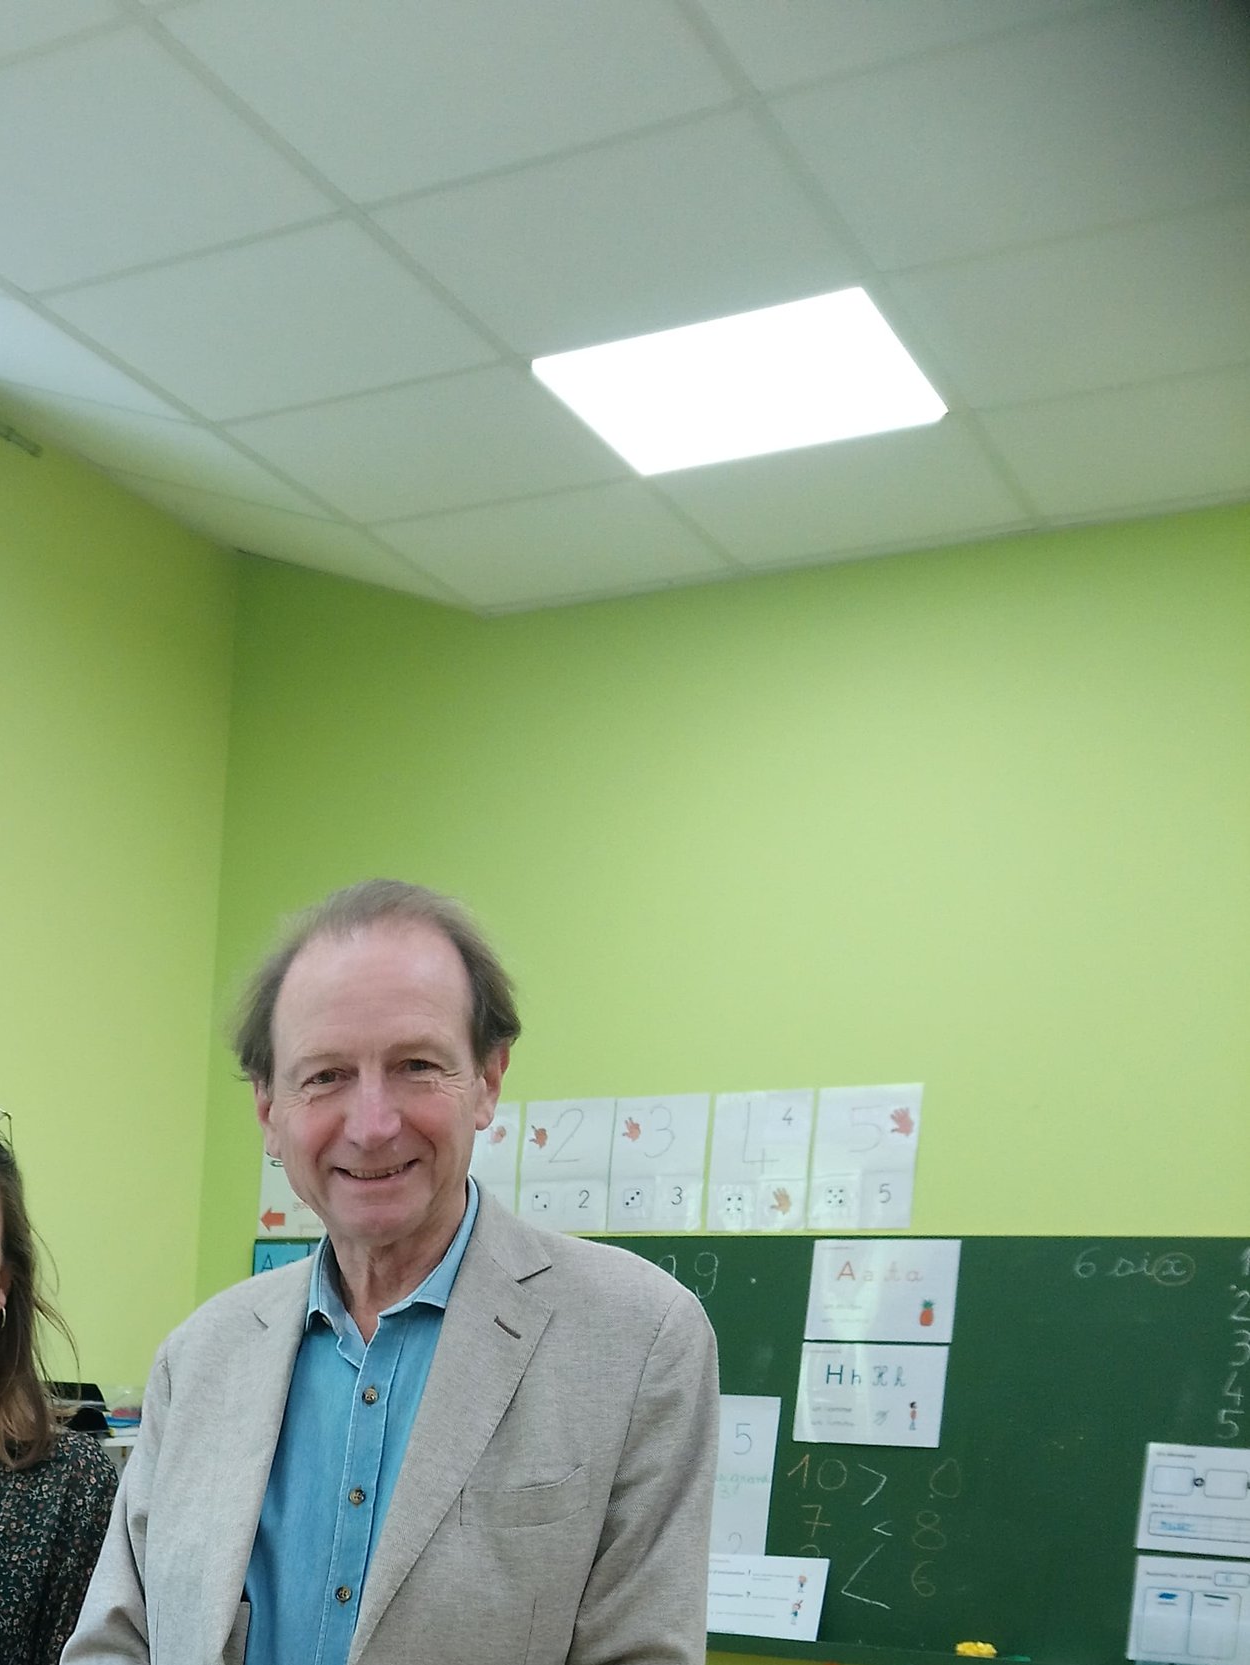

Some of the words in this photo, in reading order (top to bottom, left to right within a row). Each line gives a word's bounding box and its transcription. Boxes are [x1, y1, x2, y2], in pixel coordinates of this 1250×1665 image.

[644, 1105, 676, 1158] 3
[781, 1106, 794, 1126] 4
[549, 1107, 584, 1163] 2
[578, 1189, 591, 1209] 2
[670, 1186, 684, 1206] 3
[879, 1183, 892, 1204] 5
[1075, 1247, 1100, 1278] 6
[1228, 1289, 1250, 1322] 2
[825, 1363, 844, 1386] H
[850, 1368, 863, 1386] h
[1224, 1370, 1245, 1406] 4
[733, 1422, 753, 1456] 5
[1216, 1409, 1245, 1439] 5
[787, 1453, 848, 1491] 10
[800, 1503, 833, 1538] 7
[910, 1509, 948, 1551] 8
